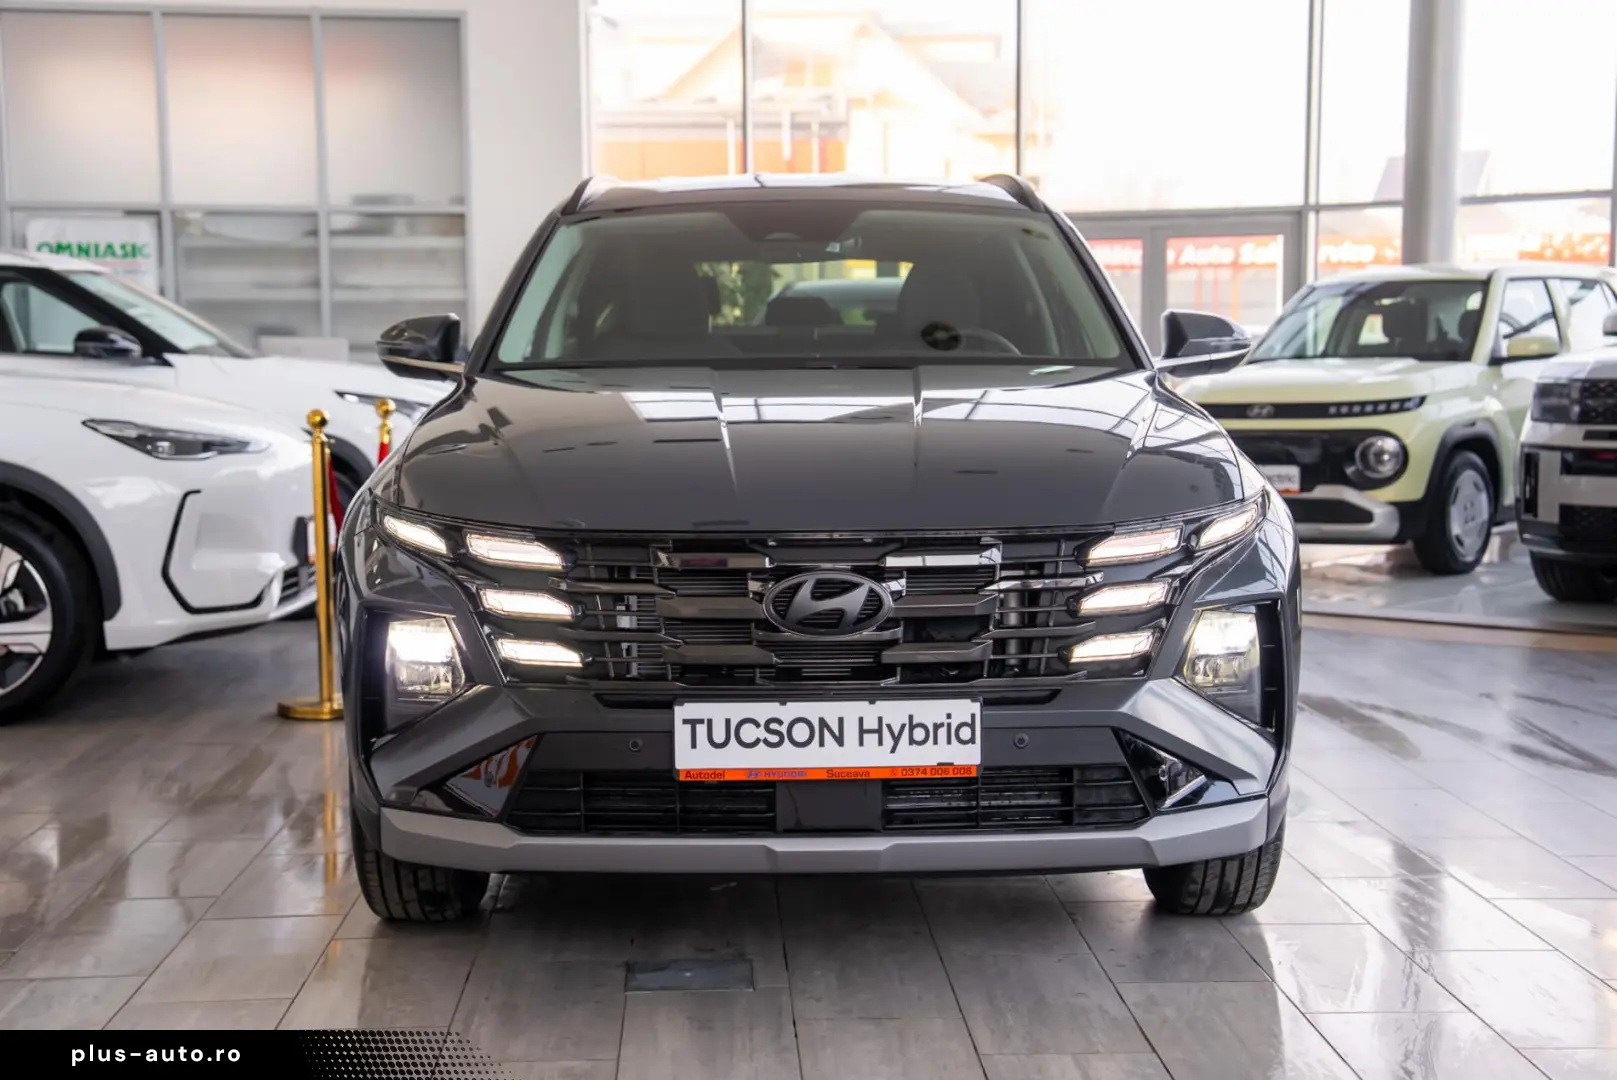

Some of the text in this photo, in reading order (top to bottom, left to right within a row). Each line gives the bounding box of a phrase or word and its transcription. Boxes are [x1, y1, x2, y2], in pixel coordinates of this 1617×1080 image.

[682, 712, 977, 754] TUCSON Hybrid
[684, 770, 726, 780] Autodel
[825, 769, 871, 778] Suceava
[901, 767, 928, 777] 0374
